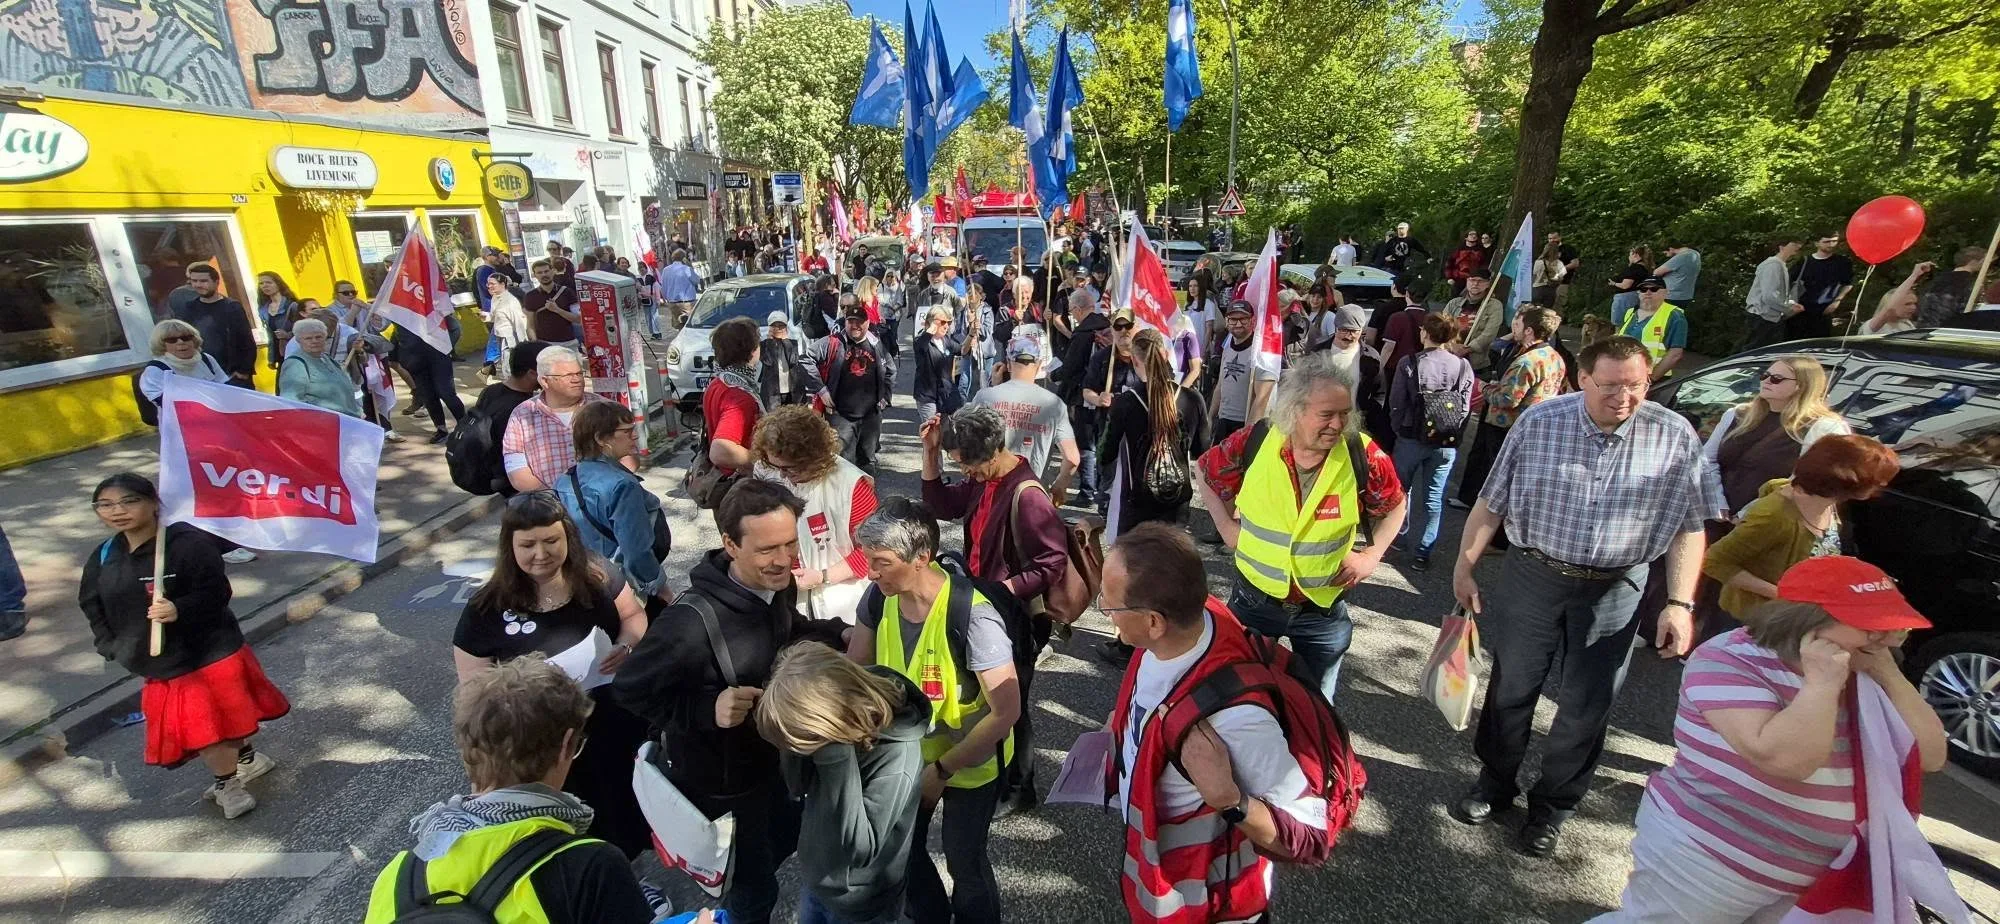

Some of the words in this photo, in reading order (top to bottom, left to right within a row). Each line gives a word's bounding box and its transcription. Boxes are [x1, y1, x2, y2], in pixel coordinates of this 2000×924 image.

[297, 153, 325, 165] ROCK
[329, 154, 358, 167] BLUES
[306, 169, 357, 182] LIVEMUSIC
[492, 174, 522, 190] JEVER
[992, 401, 1010, 411] WIR
[1011, 403, 1041, 414] LASSEN
[1010, 411, 1032, 422] NICHT
[199, 462, 342, 516] ver.di
[1315, 506, 1338, 515] ver.di
